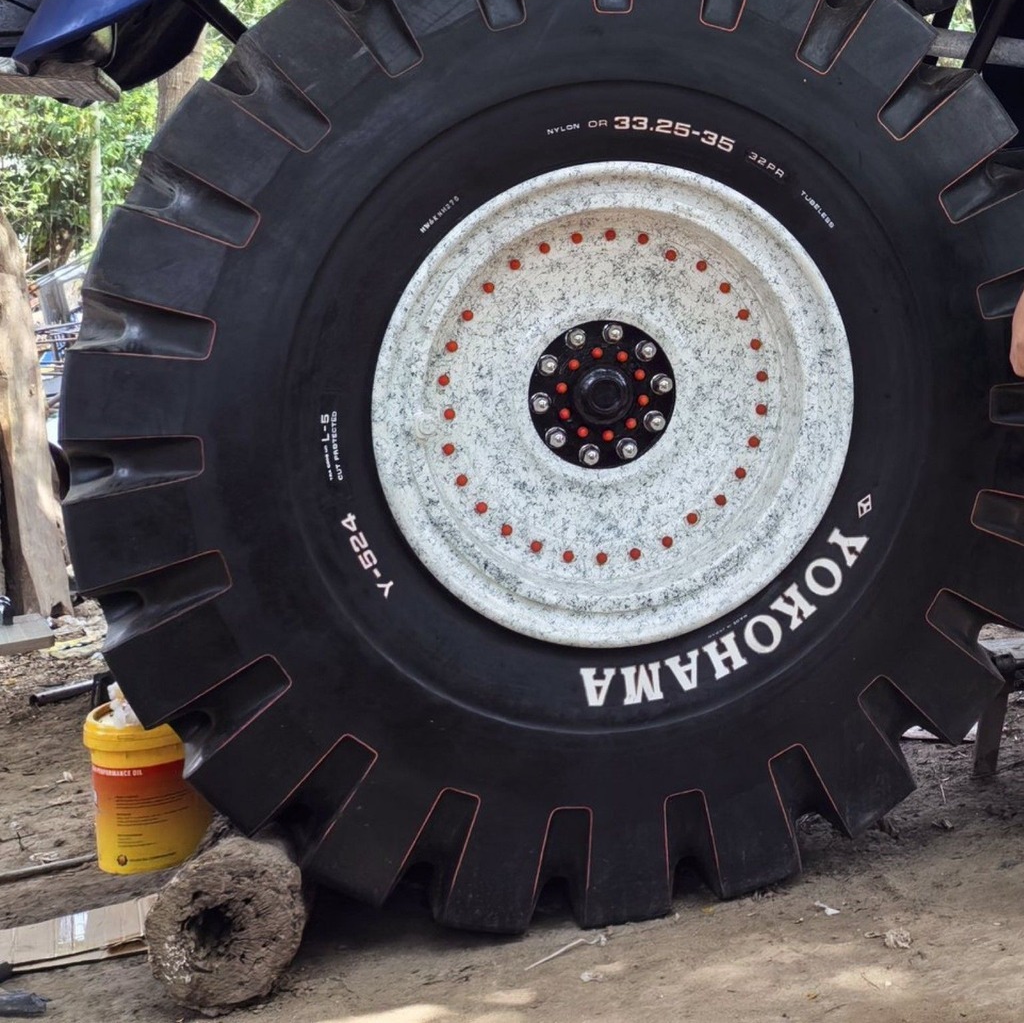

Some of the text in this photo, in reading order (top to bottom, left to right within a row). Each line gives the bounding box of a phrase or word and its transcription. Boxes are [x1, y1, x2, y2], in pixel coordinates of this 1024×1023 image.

[547, 116, 835, 228] NYLON OR 33.25-35 32PR TUBELESS
[335, 464, 343, 481] CUT
[341, 512, 394, 599] Y-524
[579, 527, 869, 707] YOKOHAMA
